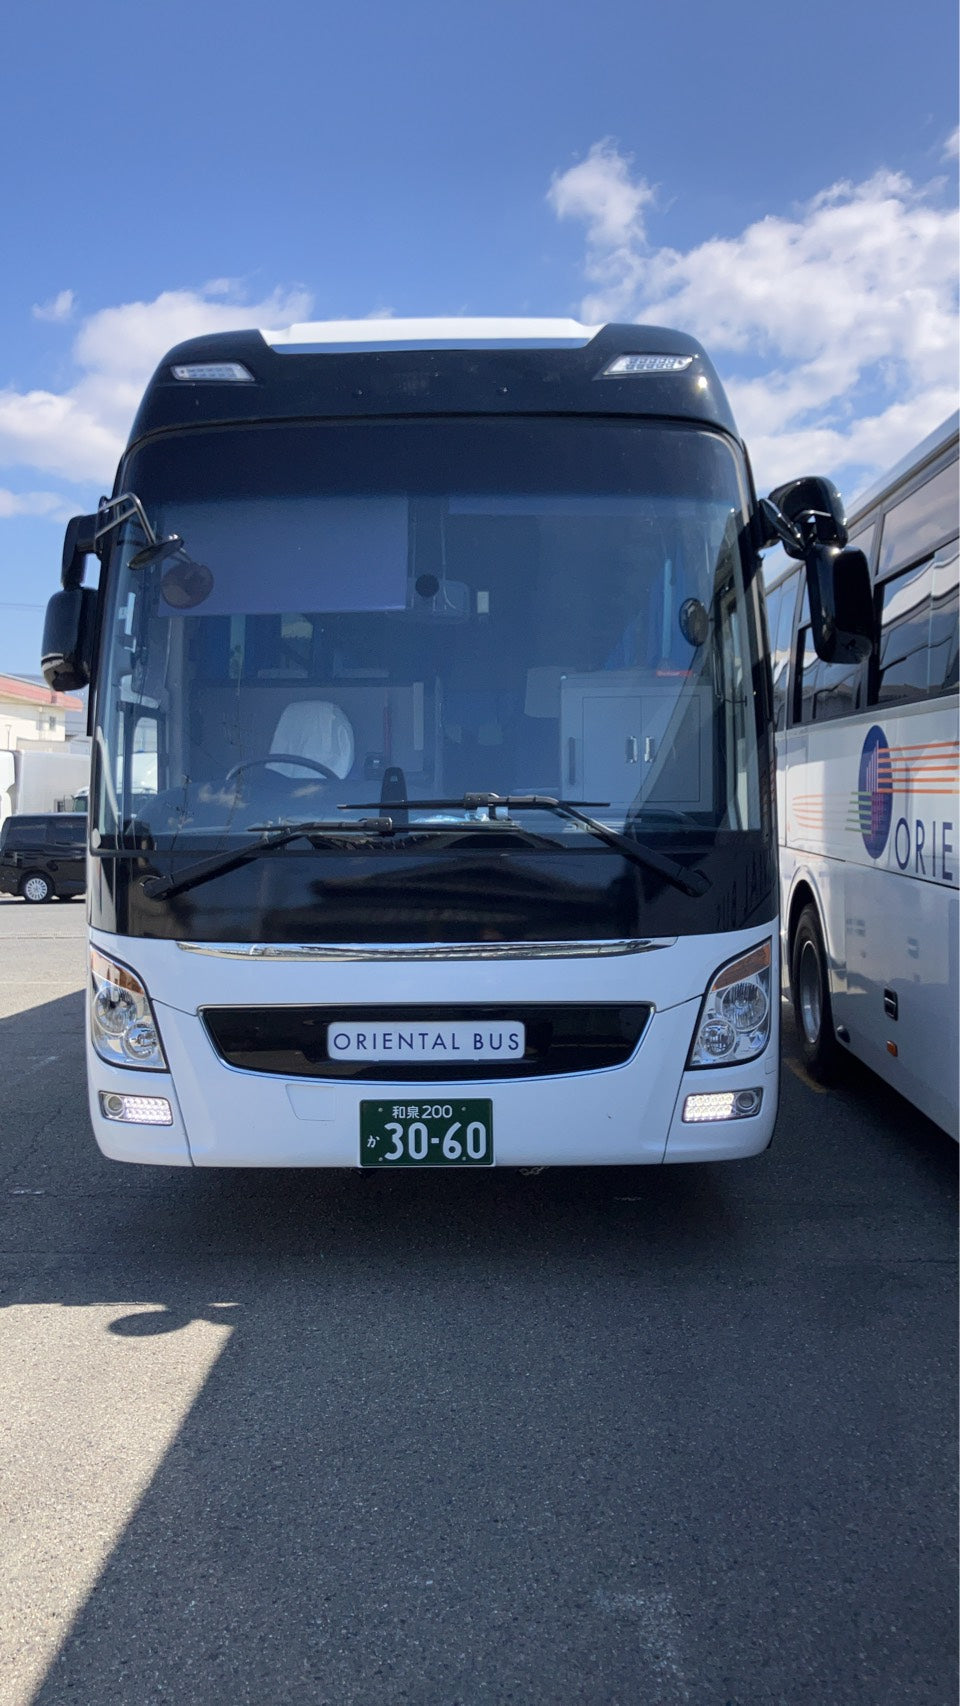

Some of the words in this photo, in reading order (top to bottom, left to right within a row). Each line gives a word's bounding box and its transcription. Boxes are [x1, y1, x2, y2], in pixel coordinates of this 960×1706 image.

[895, 817, 953, 881] ORIE
[333, 1033, 460, 1050] ORIENTAL
[473, 1033, 519, 1050] BUS
[367, 1135, 380, 1148] か
[384, 1121, 486, 1160] 30-60
